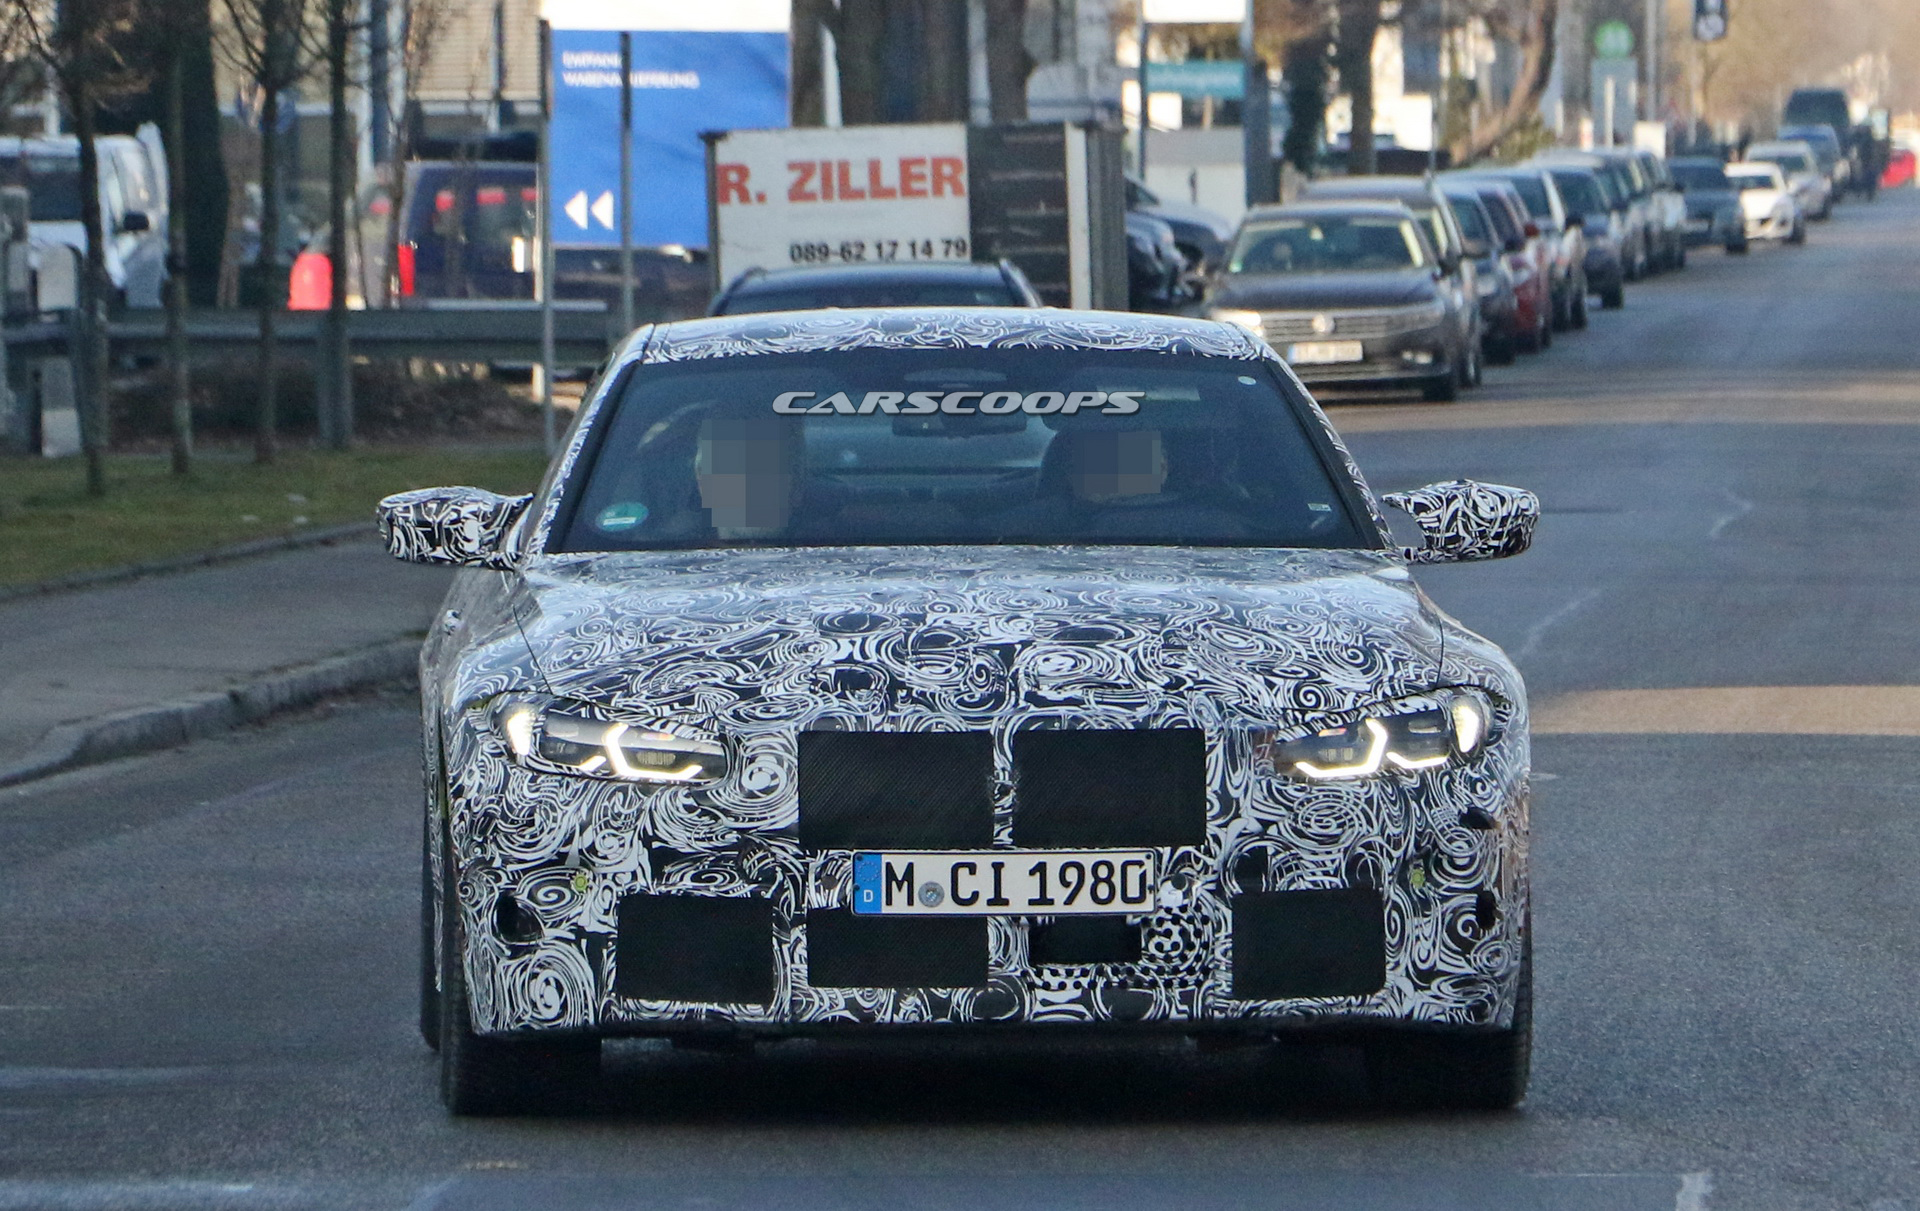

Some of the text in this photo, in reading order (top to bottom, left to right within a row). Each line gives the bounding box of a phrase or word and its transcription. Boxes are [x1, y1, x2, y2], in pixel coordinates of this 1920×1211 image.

[716, 156, 966, 205] R. ZILLER
[790, 240, 866, 263] 089-62
[908, 239, 933, 259] 14
[941, 237, 967, 258] 79
[863, 889, 874, 903] D
[885, 859, 1148, 907] M CI 1980
